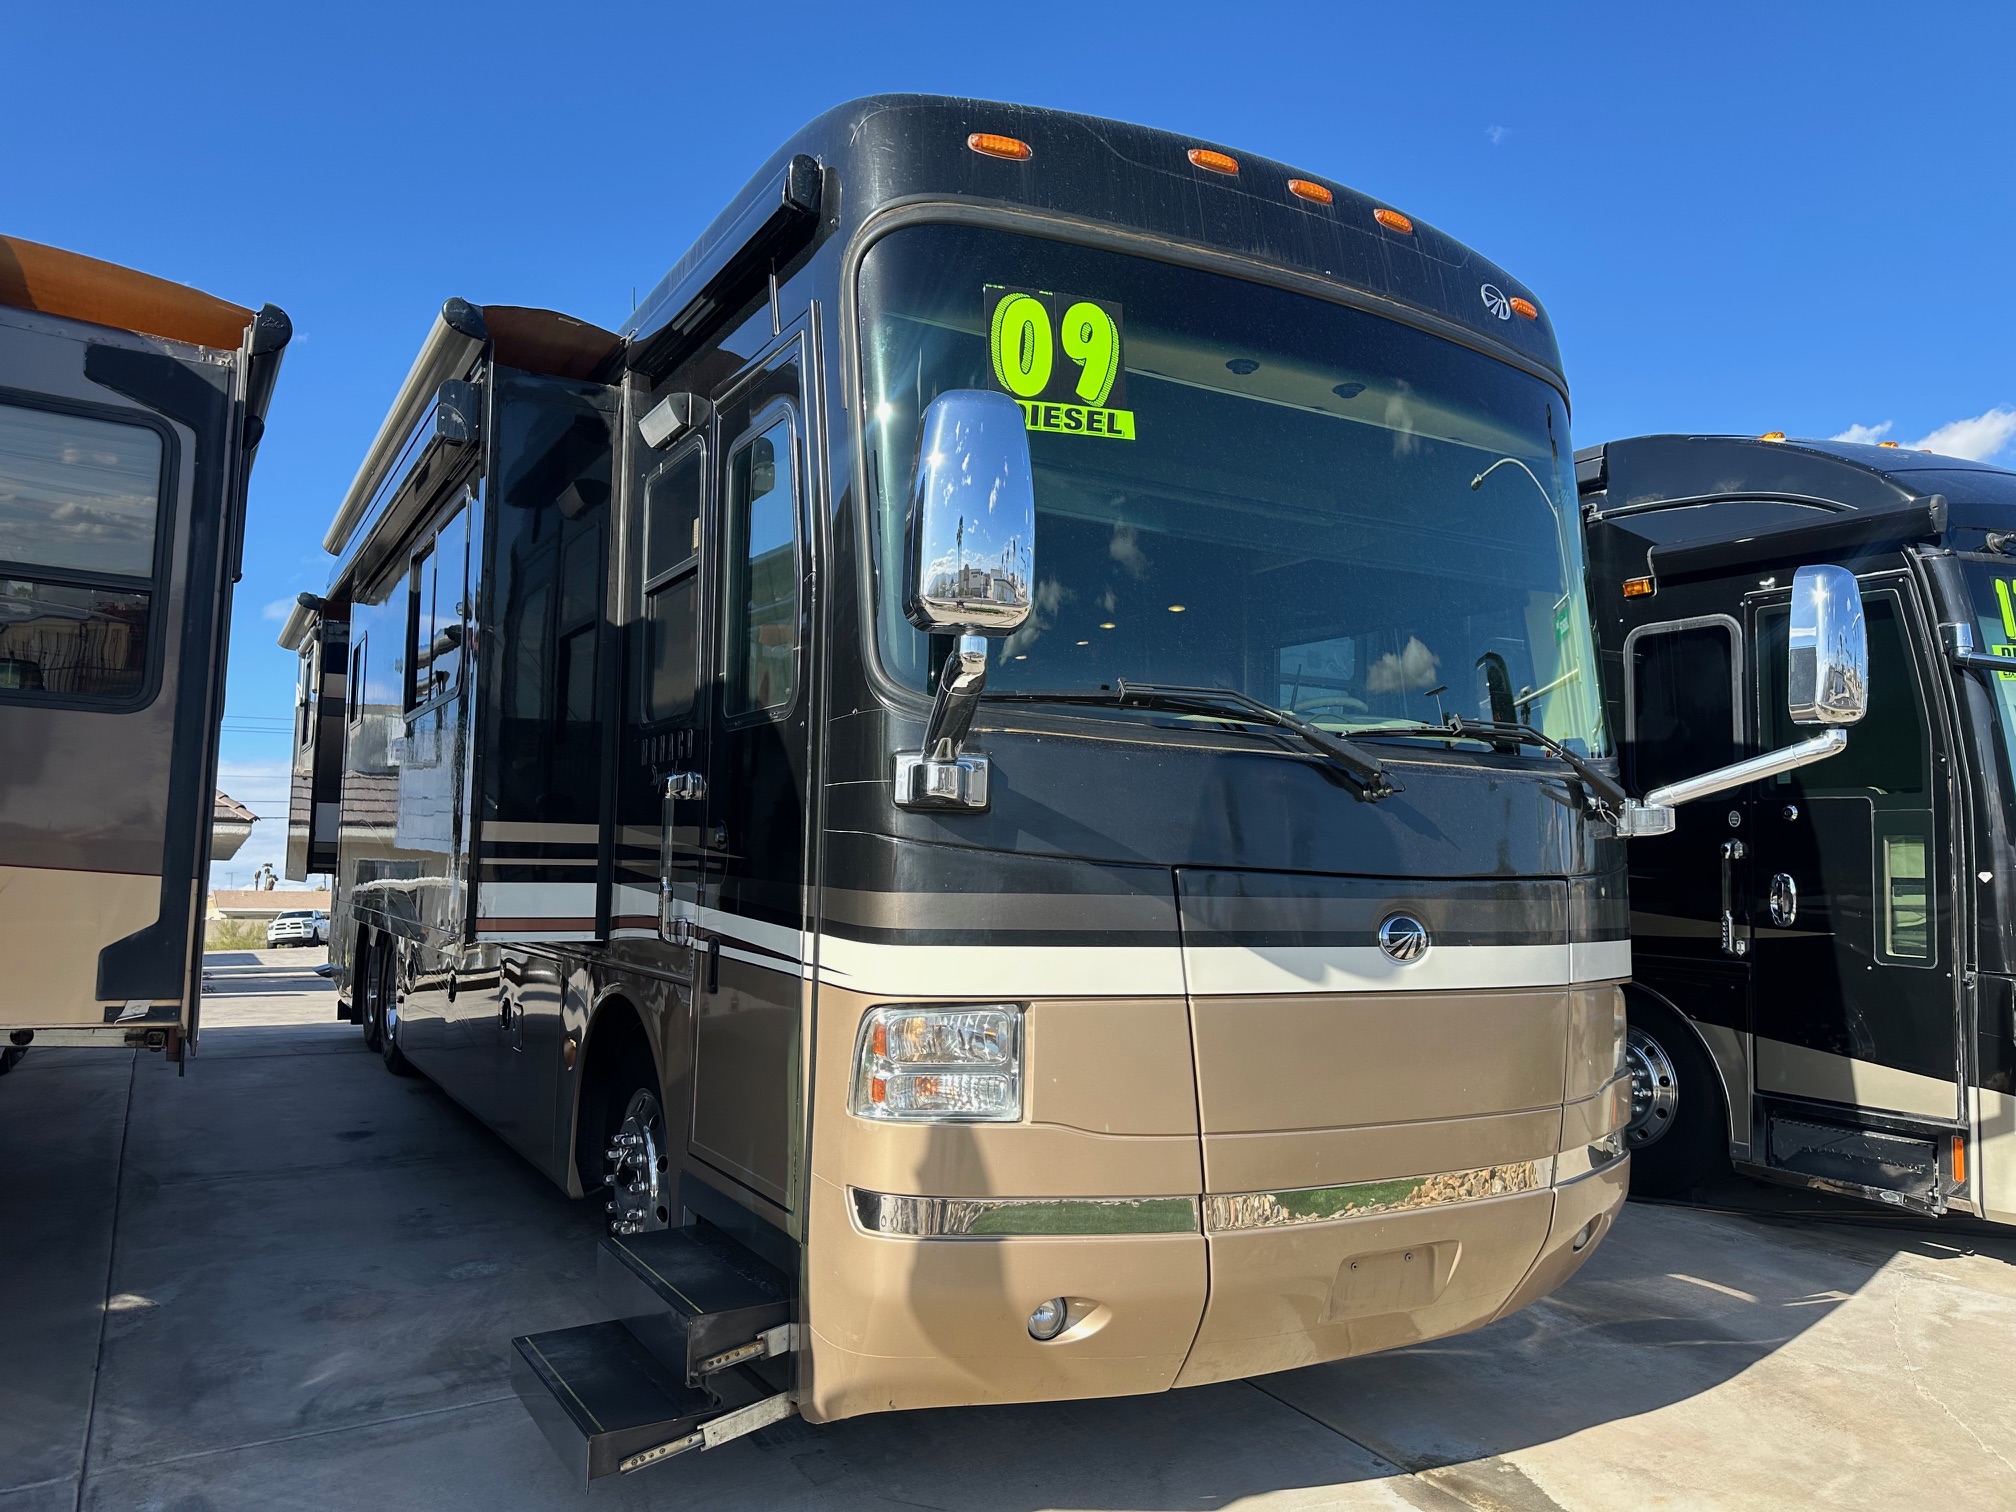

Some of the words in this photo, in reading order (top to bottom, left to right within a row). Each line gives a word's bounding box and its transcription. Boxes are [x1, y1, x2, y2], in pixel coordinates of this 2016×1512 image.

[991, 293, 1119, 407] 09
[1019, 404, 1125, 437] IESEL
[641, 728, 694, 766] MONACO
